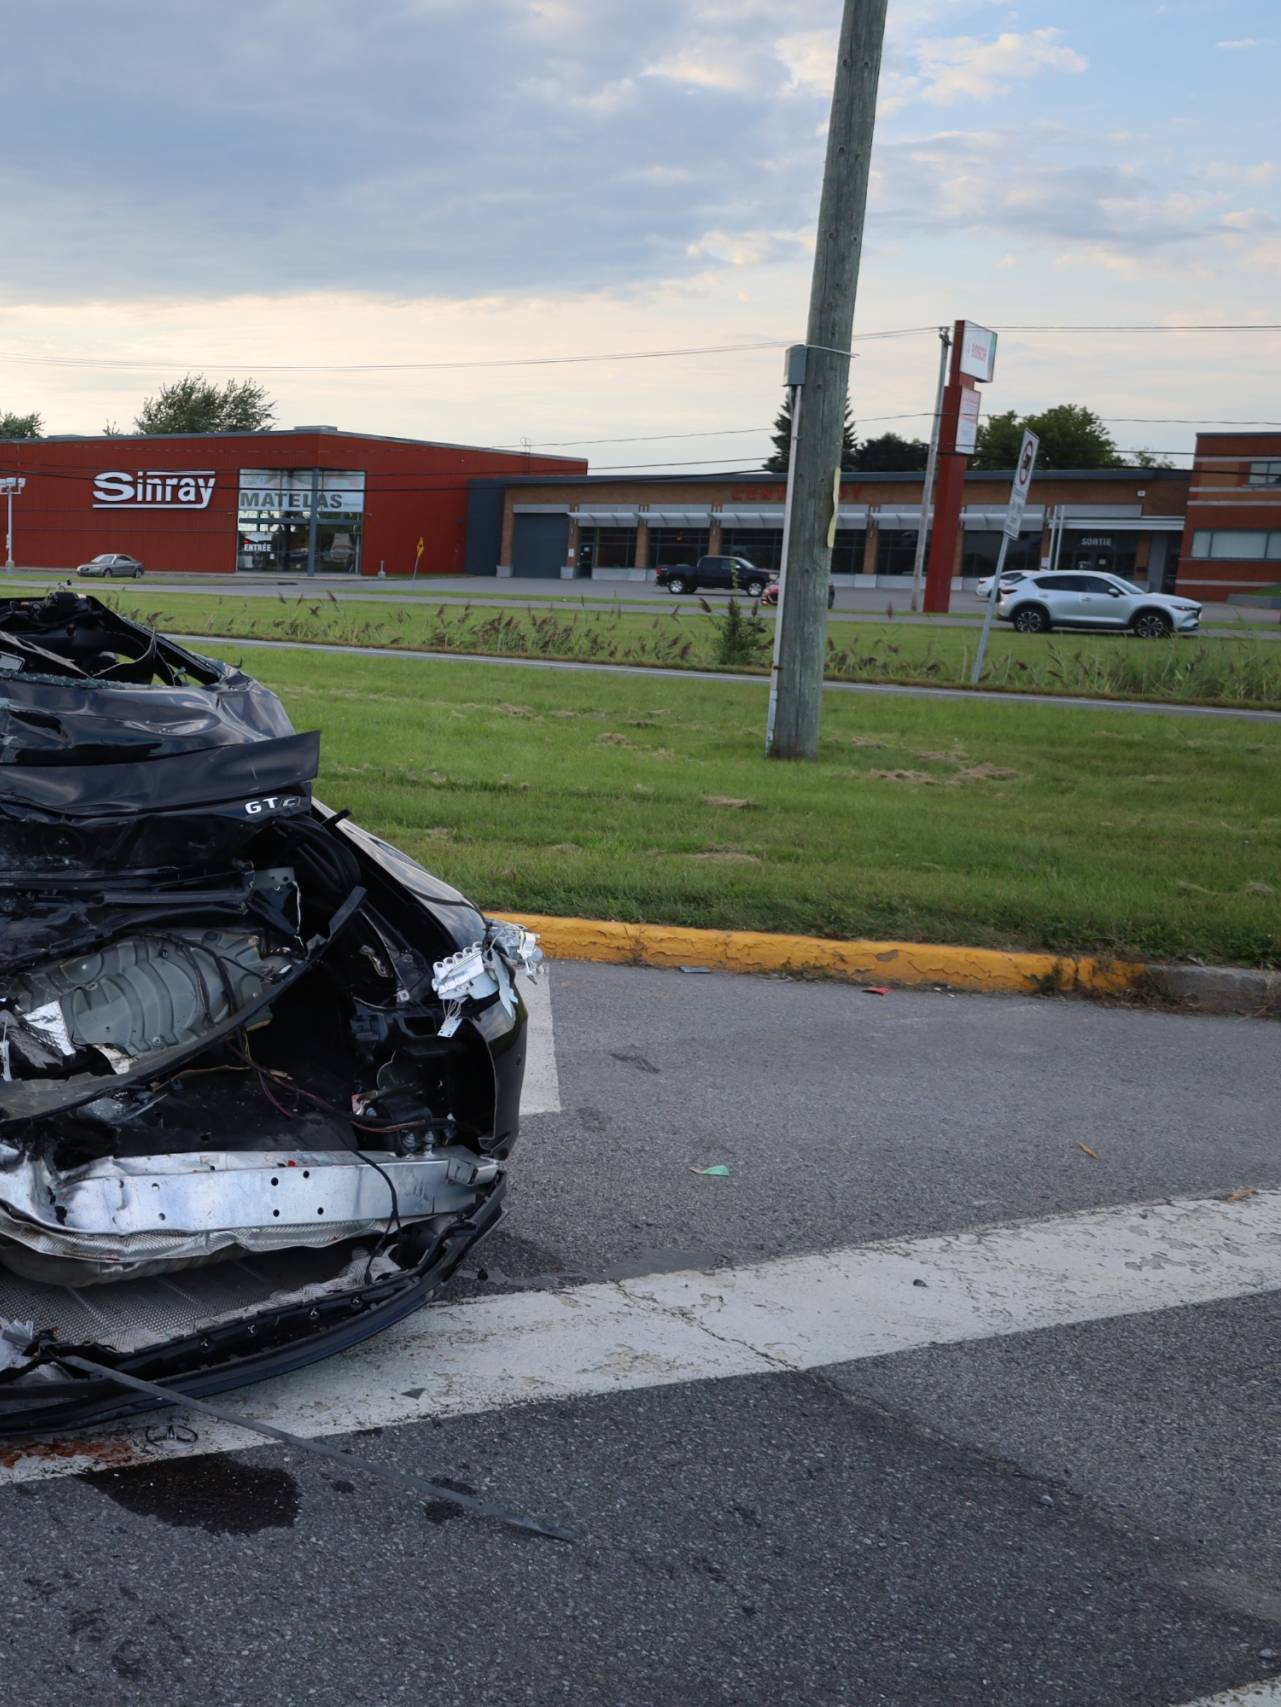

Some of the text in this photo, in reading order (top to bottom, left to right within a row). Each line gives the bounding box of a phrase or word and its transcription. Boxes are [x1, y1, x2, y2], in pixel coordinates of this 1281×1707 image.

[92, 470, 216, 509] Sinray
[240, 492, 343, 509] MATELAS
[243, 543, 272, 552] ENTRÉE
